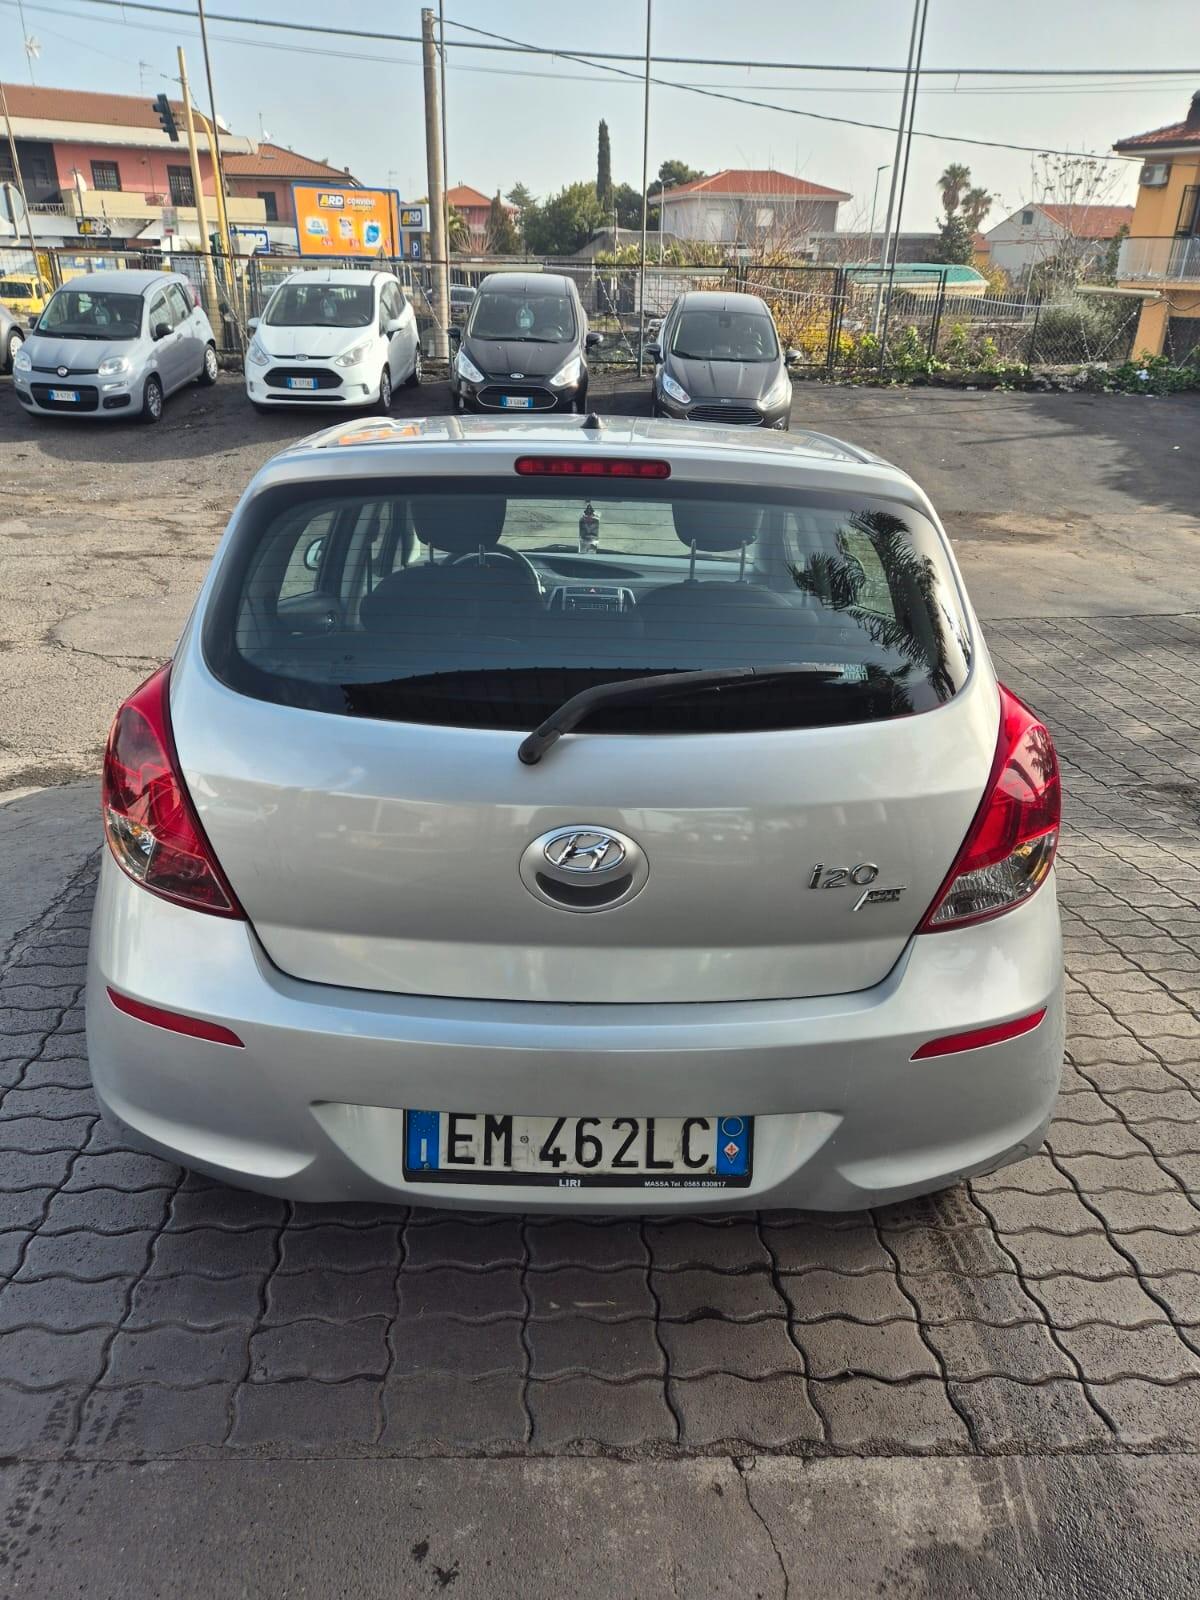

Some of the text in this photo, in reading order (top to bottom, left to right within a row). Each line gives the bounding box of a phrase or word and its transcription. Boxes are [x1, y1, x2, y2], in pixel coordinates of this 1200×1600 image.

[319, 194, 344, 207] ARD
[402, 211, 421, 226] ARD
[412, 241, 419, 255] P
[808, 863, 879, 889] i20
[447, 1113, 711, 1169] EM 462LC
[559, 1179, 581, 1187] LIRI
